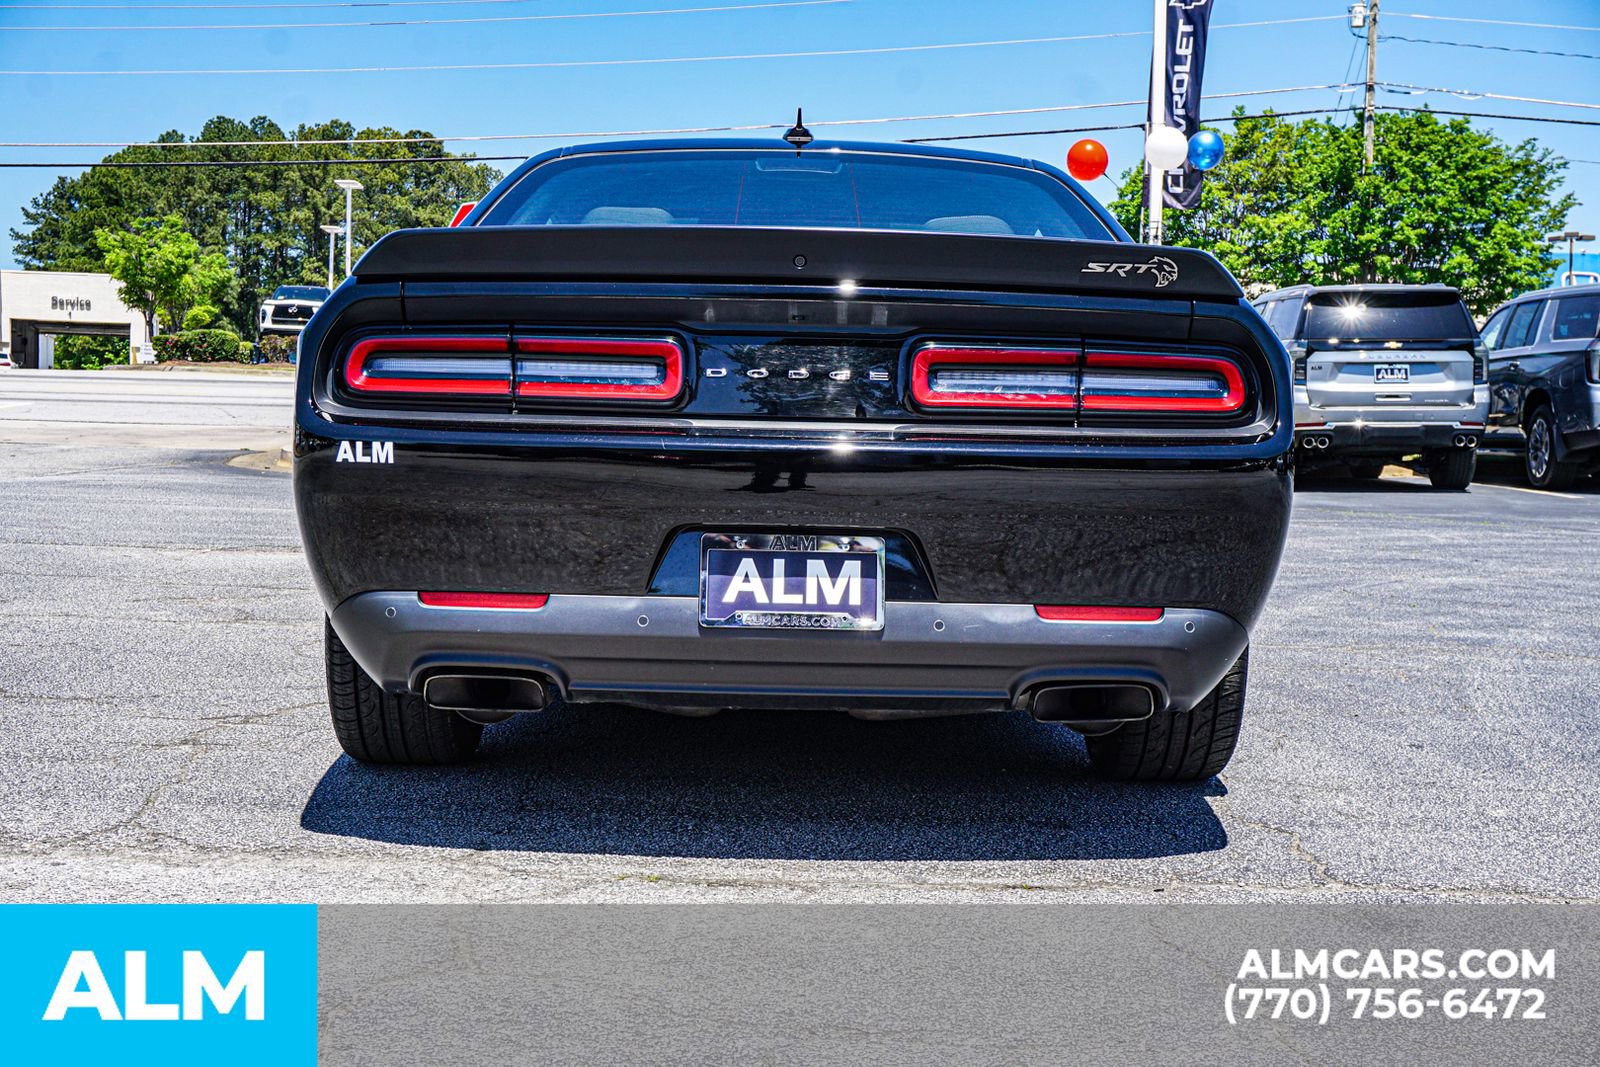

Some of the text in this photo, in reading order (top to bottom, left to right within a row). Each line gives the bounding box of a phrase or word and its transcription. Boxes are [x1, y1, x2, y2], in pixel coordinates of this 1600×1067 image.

[1167, 18, 1194, 194] CVROLET
[1081, 262, 1157, 277] SRT
[51, 296, 91, 310] Service
[705, 367, 889, 381] DODGE
[1378, 368, 1406, 379] ALM
[335, 440, 394, 464] ALM
[770, 535, 818, 551] ALM
[722, 557, 862, 606] ALM
[744, 612, 842, 628] ALMCARS.COM
